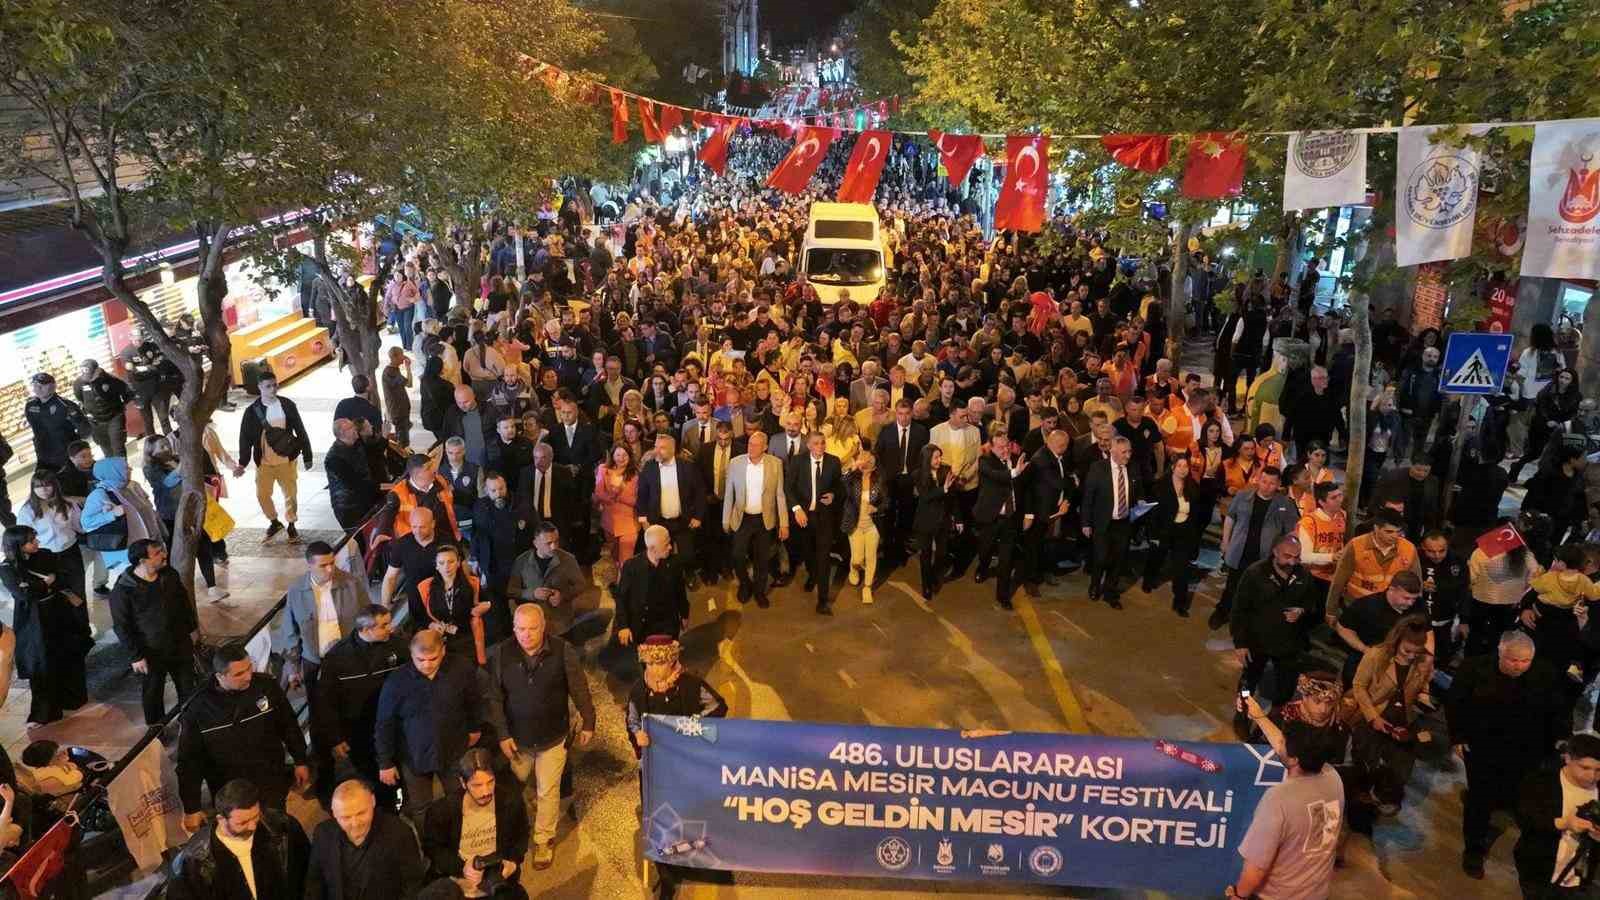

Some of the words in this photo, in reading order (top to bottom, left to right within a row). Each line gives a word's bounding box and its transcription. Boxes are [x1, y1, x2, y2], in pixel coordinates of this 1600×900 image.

[1491, 287, 1504, 303] 20
[829, 742, 889, 765] 486.
[896, 745, 1122, 779] ULUSLARARASI
[942, 777, 1076, 802] MACUNU
[817, 797, 944, 831] GELDİN
[1081, 816, 1228, 848] KORTEJİ
